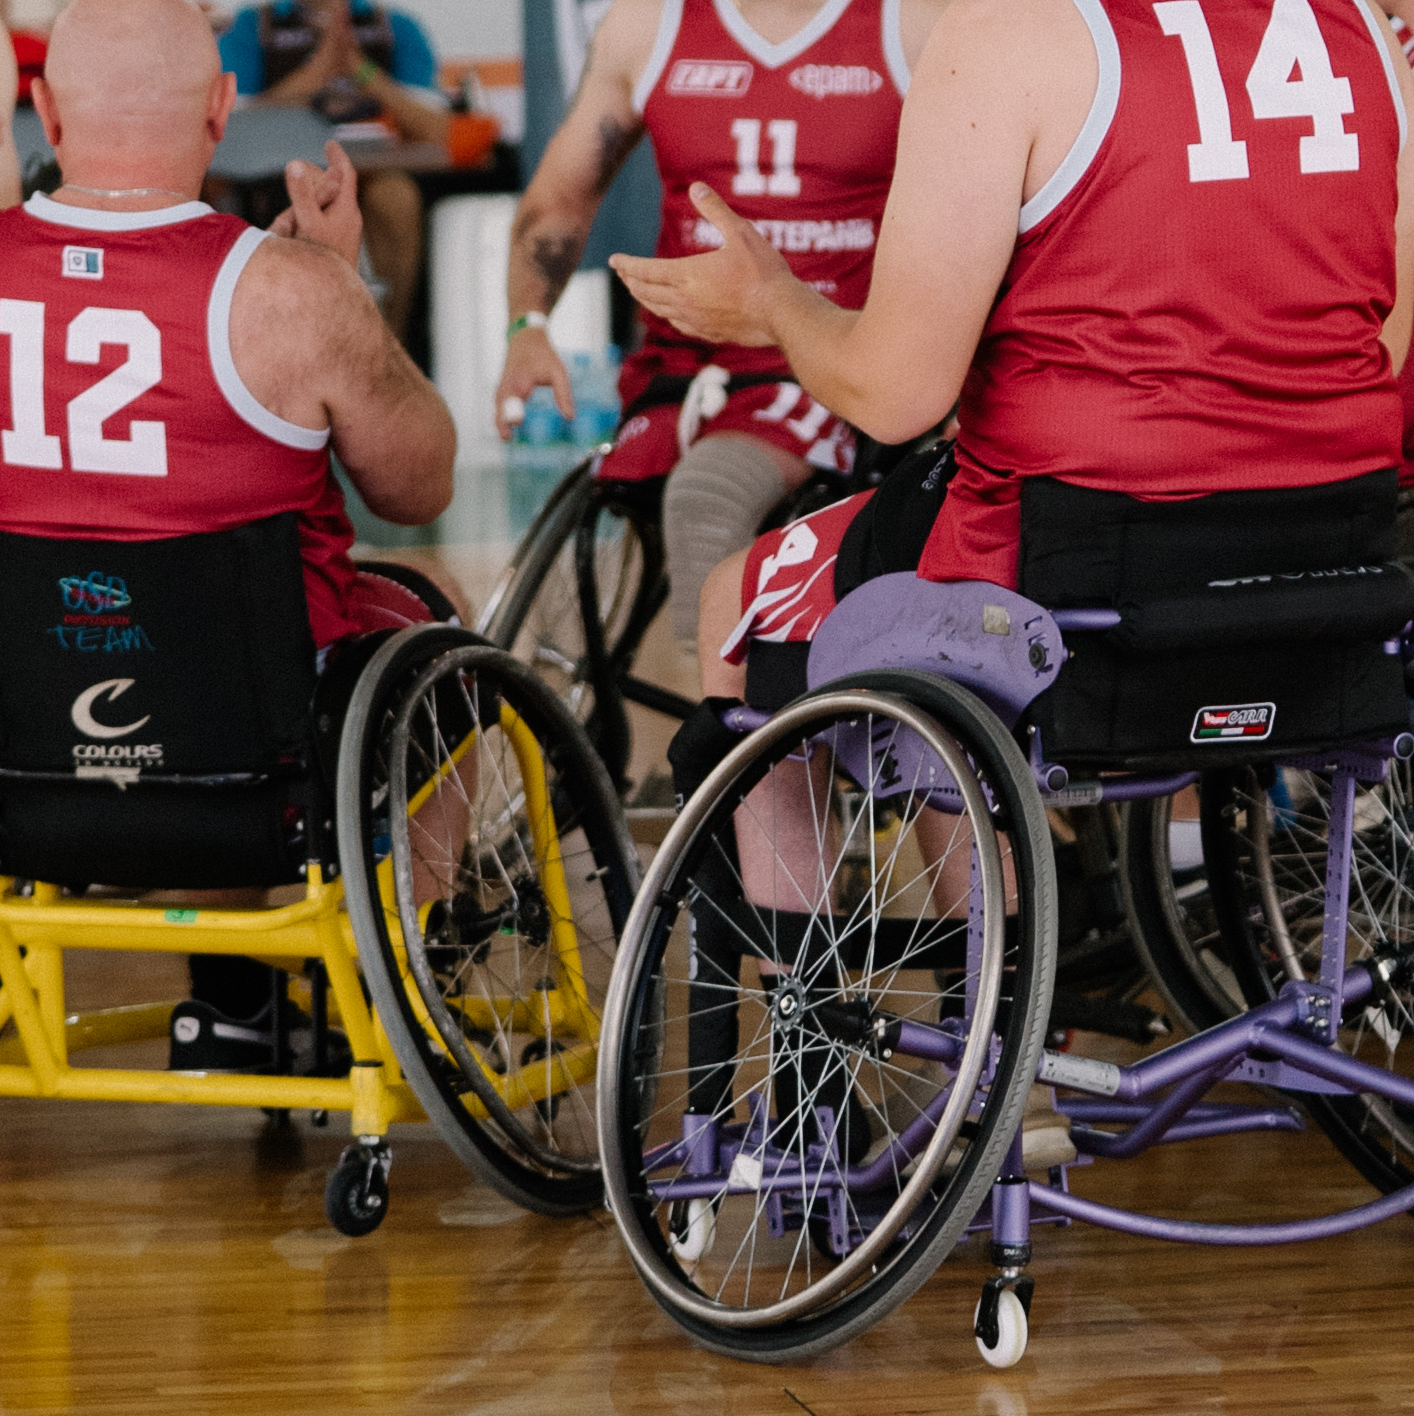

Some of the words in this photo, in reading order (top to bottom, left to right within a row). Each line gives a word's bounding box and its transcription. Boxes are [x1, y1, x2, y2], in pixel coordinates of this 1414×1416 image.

[730, 118, 801, 197] 11
[45, 625, 156, 653] TEAM
[72, 743, 164, 758] COLOURS
